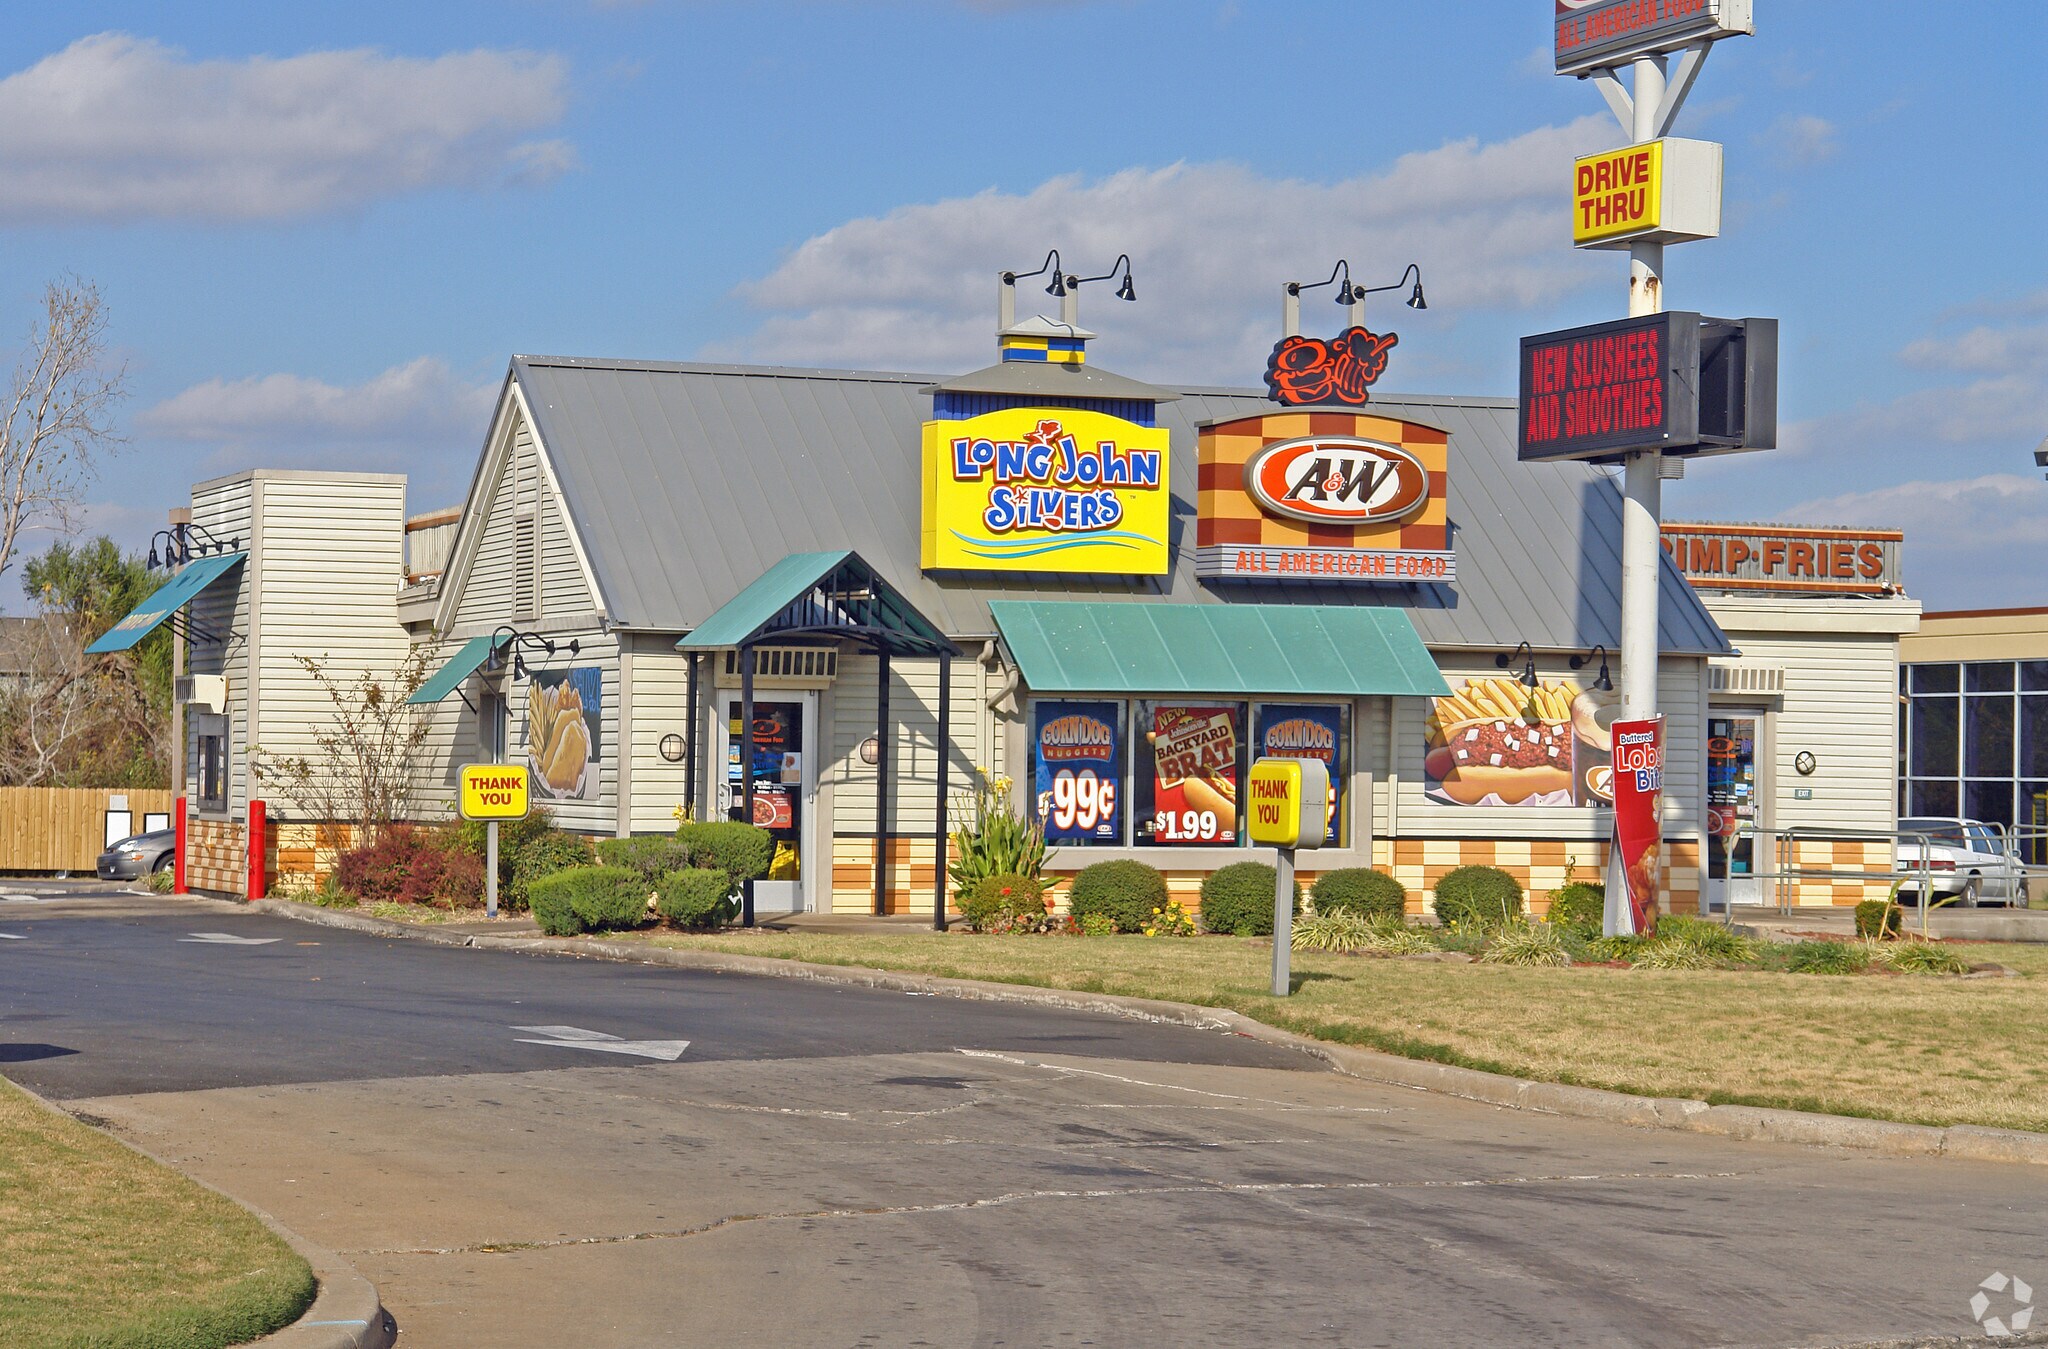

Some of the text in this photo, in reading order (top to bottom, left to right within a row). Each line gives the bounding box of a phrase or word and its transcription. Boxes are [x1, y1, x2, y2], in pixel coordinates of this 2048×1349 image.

[1557, 19, 1581, 52] ALL
[1585, 0, 1658, 44] AMERICAN
[1578, 152, 1649, 196] DRIVE
[1580, 188, 1645, 229] THRU
[1532, 329, 1658, 394] NEW SLUSHEES
[1526, 378, 1663, 443] AND SMOOTHIES
[952, 438, 1055, 482] LONG
[1282, 457, 1402, 504] A&W
[983, 485, 1122, 532] SILVER'S
[1235, 550, 1447, 578] ALL AMERICAN FOOD
[1041, 716, 1112, 746] CORN DOG
[1158, 707, 1187, 731] NEW
[1156, 725, 1229, 760] BACKYARD
[1266, 720, 1335, 750] CORN DOG
[1620, 731, 1654, 745] Buttered
[1047, 747, 1106, 758] NUGGETS
[1160, 738, 1234, 786] BRAT
[1271, 750, 1329, 760] NUGGETS
[469, 777, 523, 790] THANK
[1251, 779, 1289, 799] THANK
[480, 793, 512, 806] YOU
[1257, 804, 1280, 825] YOU
[1156, 810, 1217, 840] $1.99
